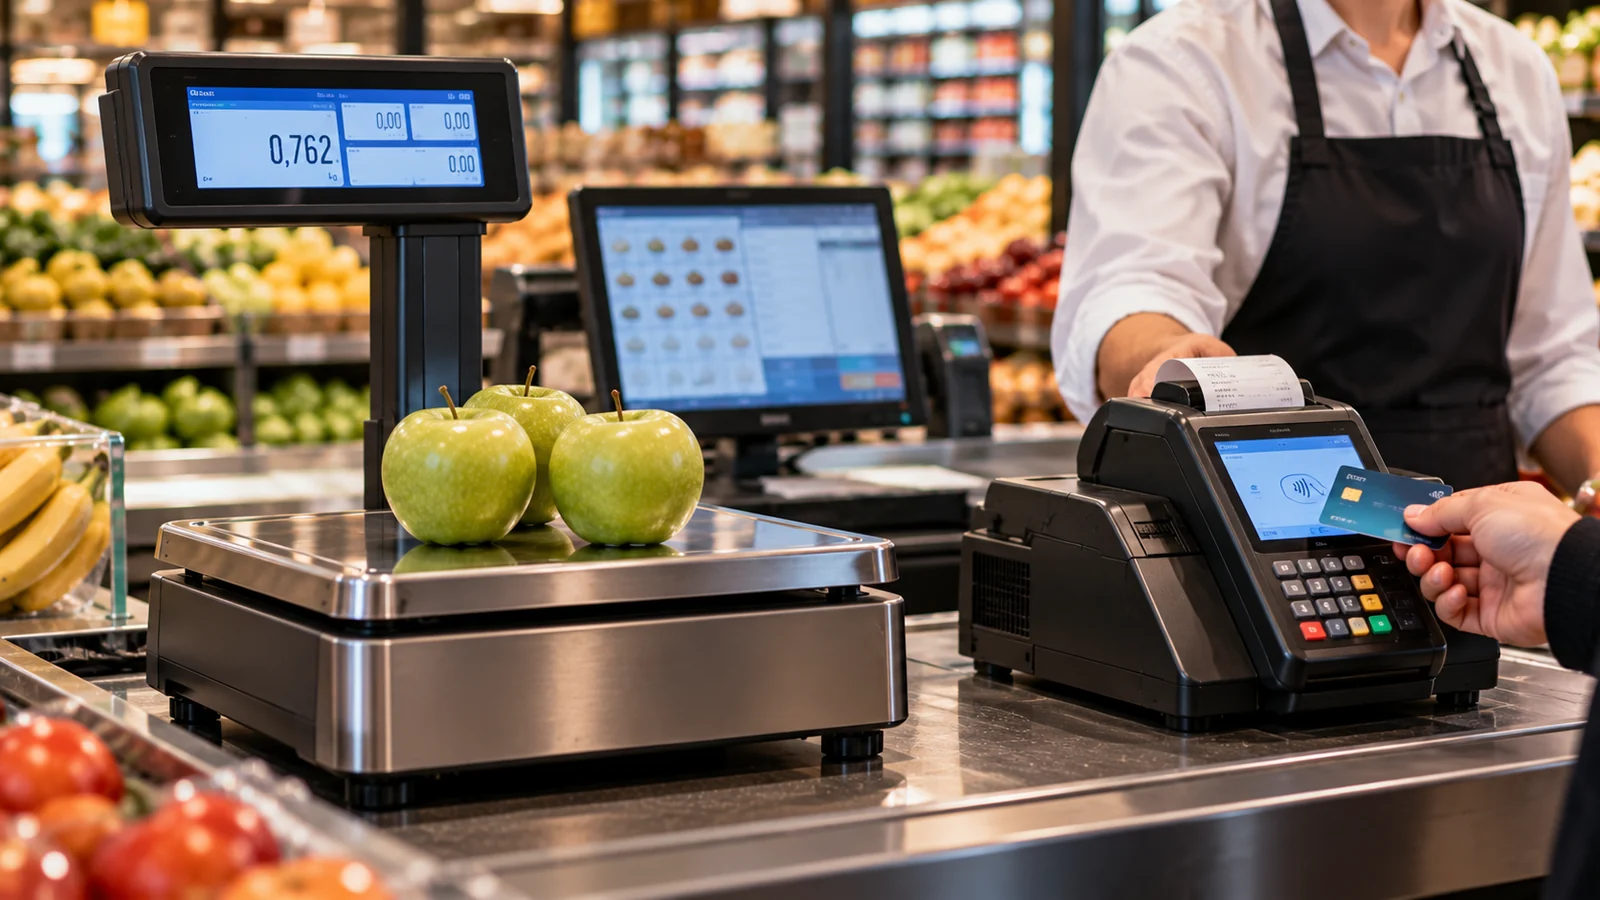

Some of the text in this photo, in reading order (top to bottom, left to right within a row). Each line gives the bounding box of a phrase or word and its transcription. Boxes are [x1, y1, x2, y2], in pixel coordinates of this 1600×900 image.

[376, 112, 402, 131] 0,00
[444, 112, 470, 131] 0,00
[269, 134, 334, 168] 0,762
